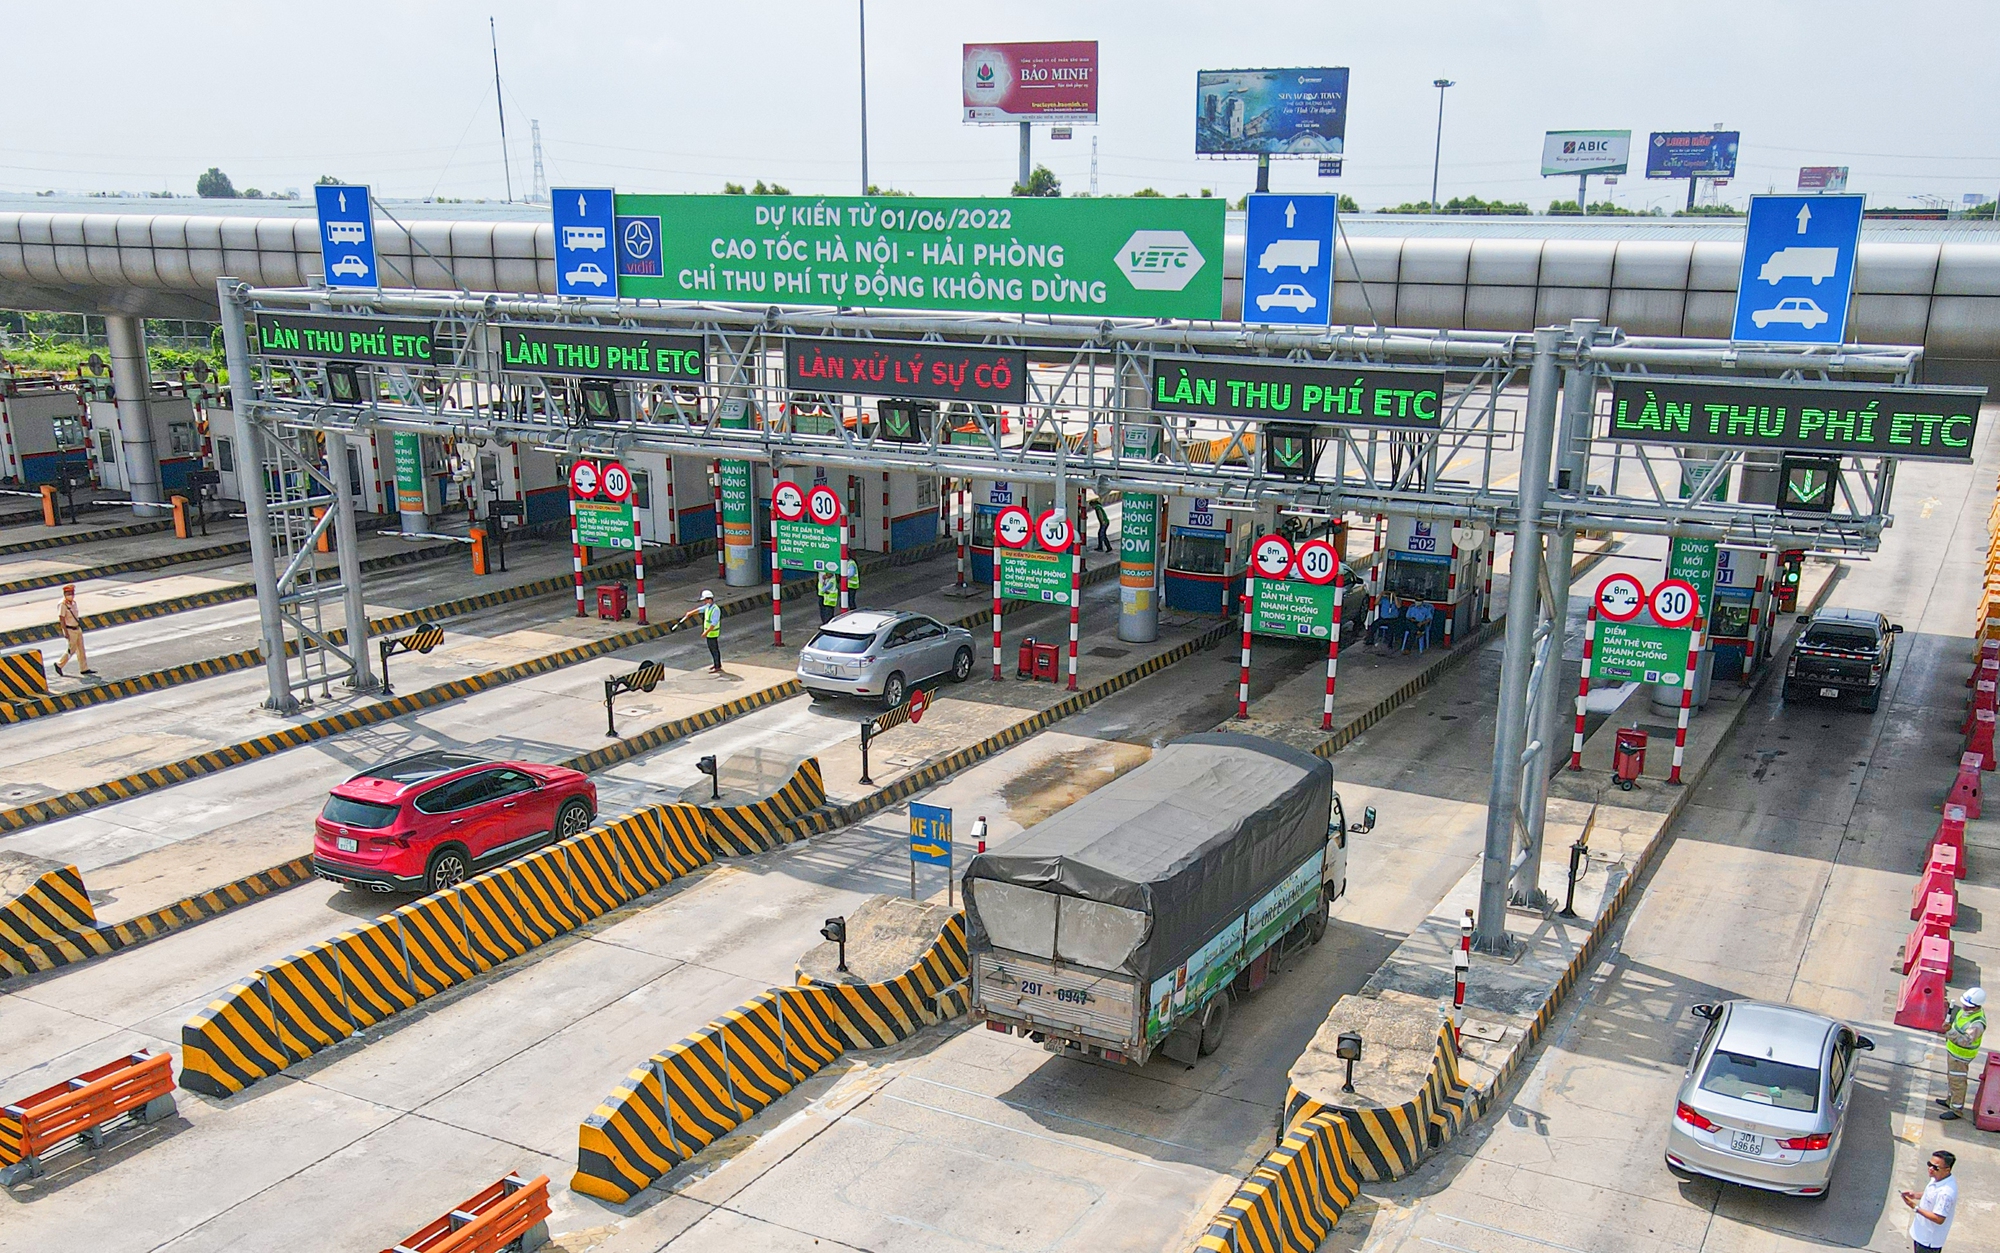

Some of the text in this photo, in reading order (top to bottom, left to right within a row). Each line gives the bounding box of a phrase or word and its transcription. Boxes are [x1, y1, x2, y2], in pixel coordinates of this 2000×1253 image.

[1021, 64, 1048, 80] BẢO
[1577, 141, 1608, 151] ABIC
[756, 199, 1011, 231] DỰ KIẾN TỪ 01/06/2022
[711, 238, 756, 260] CAO
[763, 231, 808, 261] TỐC
[815, 234, 849, 262] HÀ
[855, 235, 898, 269] NỘI
[923, 236, 964, 265] HẢI
[973, 237, 1064, 268] PHÒNG
[1131, 251, 1189, 268] VETC
[626, 260, 655, 274] vidifi
[678, 263, 1107, 303] CHỈ THU PHÍ TỰ ĐỘNG KHÔNG DỪNG
[262, 320, 431, 359] LÀN THU PHÍ ETC
[505, 333, 700, 375] LÀN THU PHÍ ETC
[798, 347, 1012, 392] LÀN XỬ LÝ SỰ CỐ
[1158, 368, 1437, 420] LÀN THU PHÍ ETC
[1616, 391, 1972, 447] LÀN THU PHÍ ETC
[609, 473, 624, 491] 30
[998, 492, 1012, 503] 04
[815, 496, 832, 515] 30
[1009, 517, 1021, 525] 8m
[1198, 514, 1212, 526] 03
[1123, 524, 1148, 536] CÁCH
[1267, 547, 1279, 555] 8m
[1419, 538, 1434, 550] 02
[1681, 541, 1709, 553] DỪNG
[1307, 551, 1328, 572] 30
[1683, 555, 1703, 566] MỚI
[1015, 567, 1026, 575] NỘI
[1031, 568, 1042, 576] HẢI
[1043, 570, 1066, 579] PHÒNG
[1718, 569, 1732, 583] 01
[1614, 586, 1628, 595] 8m
[1295, 596, 1313, 604] VETC
[1661, 592, 1686, 614] 30
[1261, 602, 1318, 615] NHANH CHÓNG
[1260, 611, 1286, 620] TRONG
[1293, 614, 1313, 623] PHÚT
[1603, 636, 1663, 650] DÁN THẺ VETC
[1602, 647, 1668, 660] NHANH CHÓNG
[1601, 656, 1625, 666] CÁCH
[911, 814, 951, 842] XE TẢI
[1021, 981, 1043, 996] 29T
[1741, 1132, 1756, 1143] 30A
